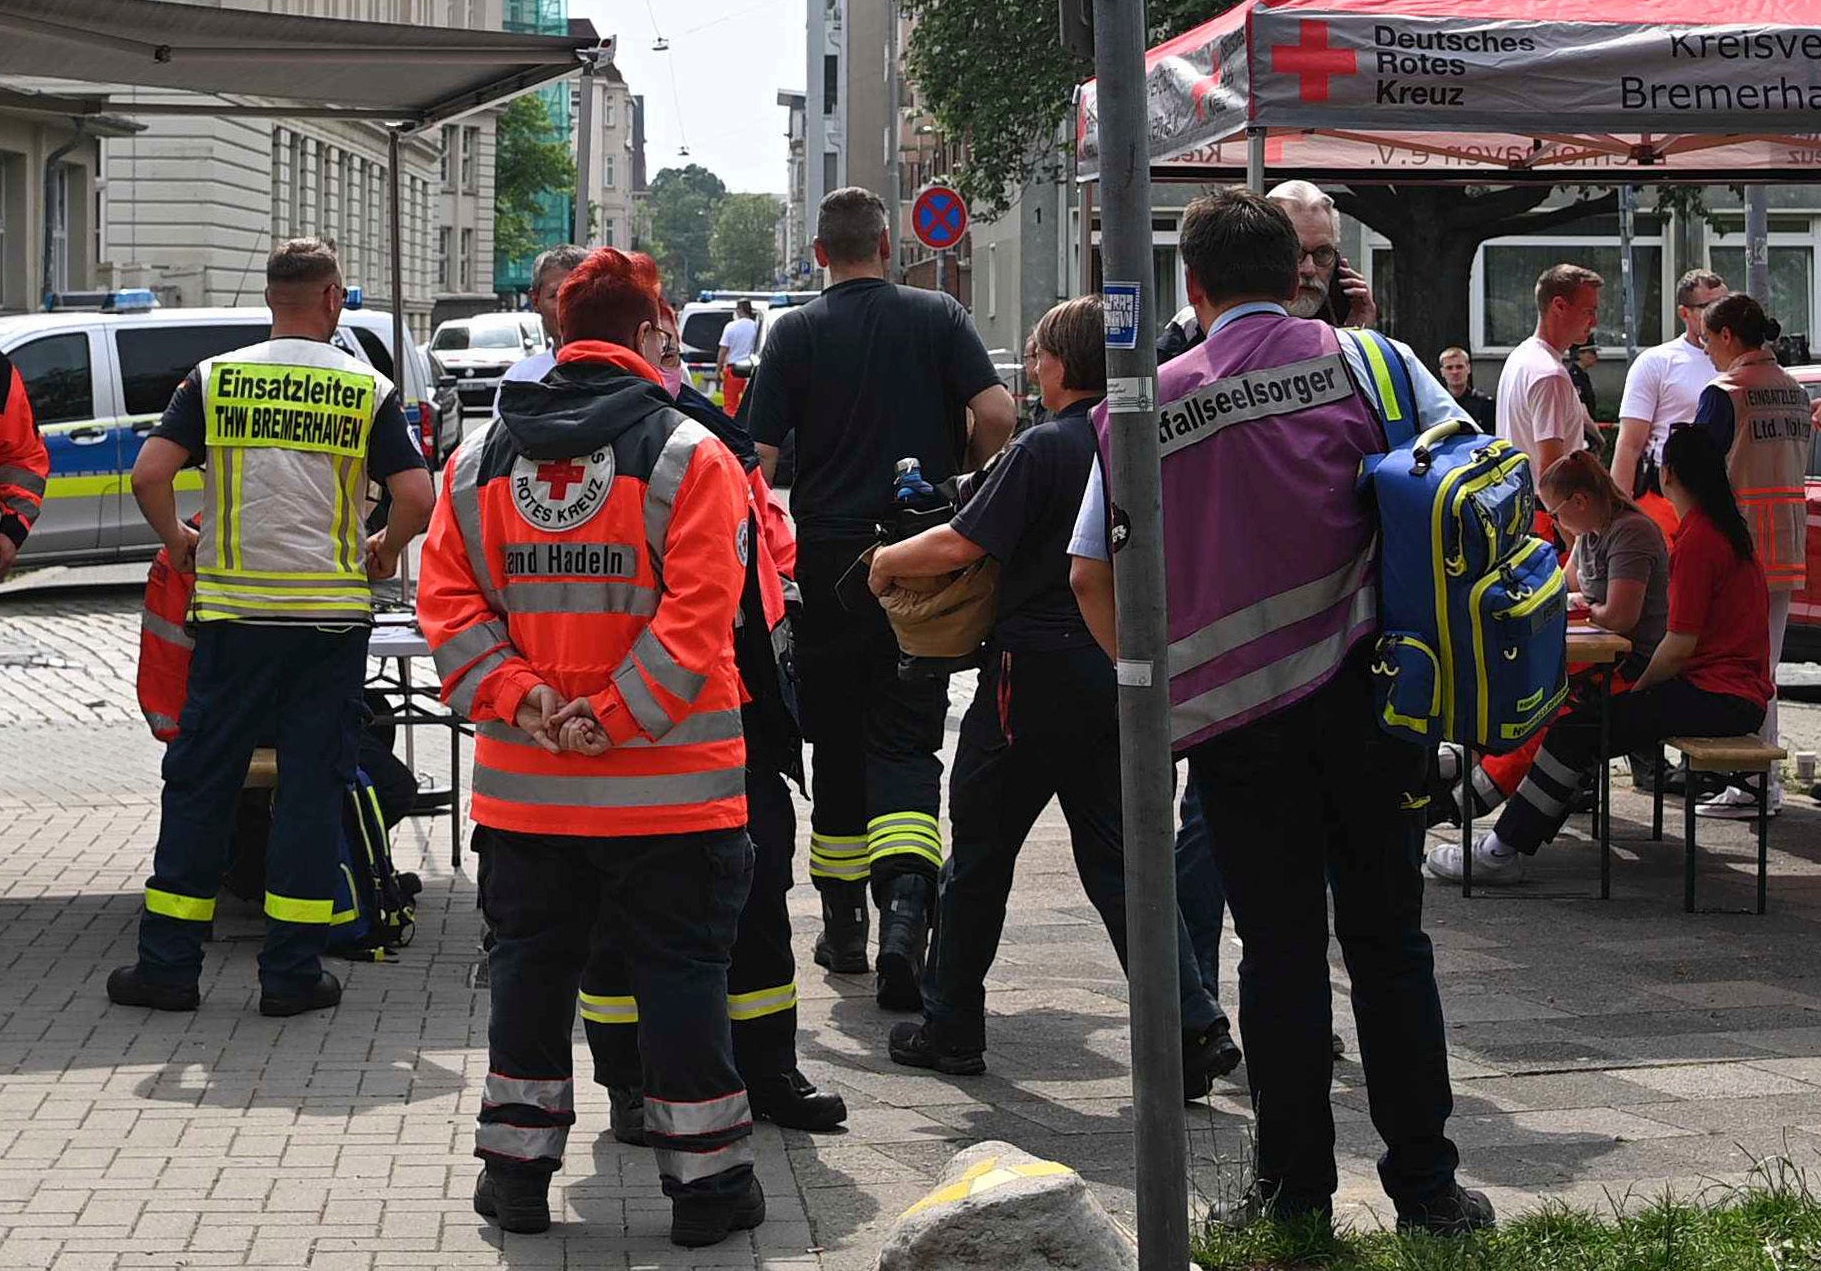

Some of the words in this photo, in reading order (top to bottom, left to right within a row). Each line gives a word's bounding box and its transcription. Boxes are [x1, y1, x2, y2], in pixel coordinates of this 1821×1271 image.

[1374, 25, 1536, 53] Deutsches
[1376, 52, 1466, 76] Rotes
[1376, 79, 1465, 106] Kreuz
[218, 368, 367, 410] Einsatzleiter
[215, 405, 248, 438] THW
[251, 407, 363, 450] BREMERHAVEN
[516, 477, 552, 522] ROTES
[558, 478, 603, 523] KREUZ
[505, 544, 537, 574] and
[548, 544, 623, 575] Hadeln
